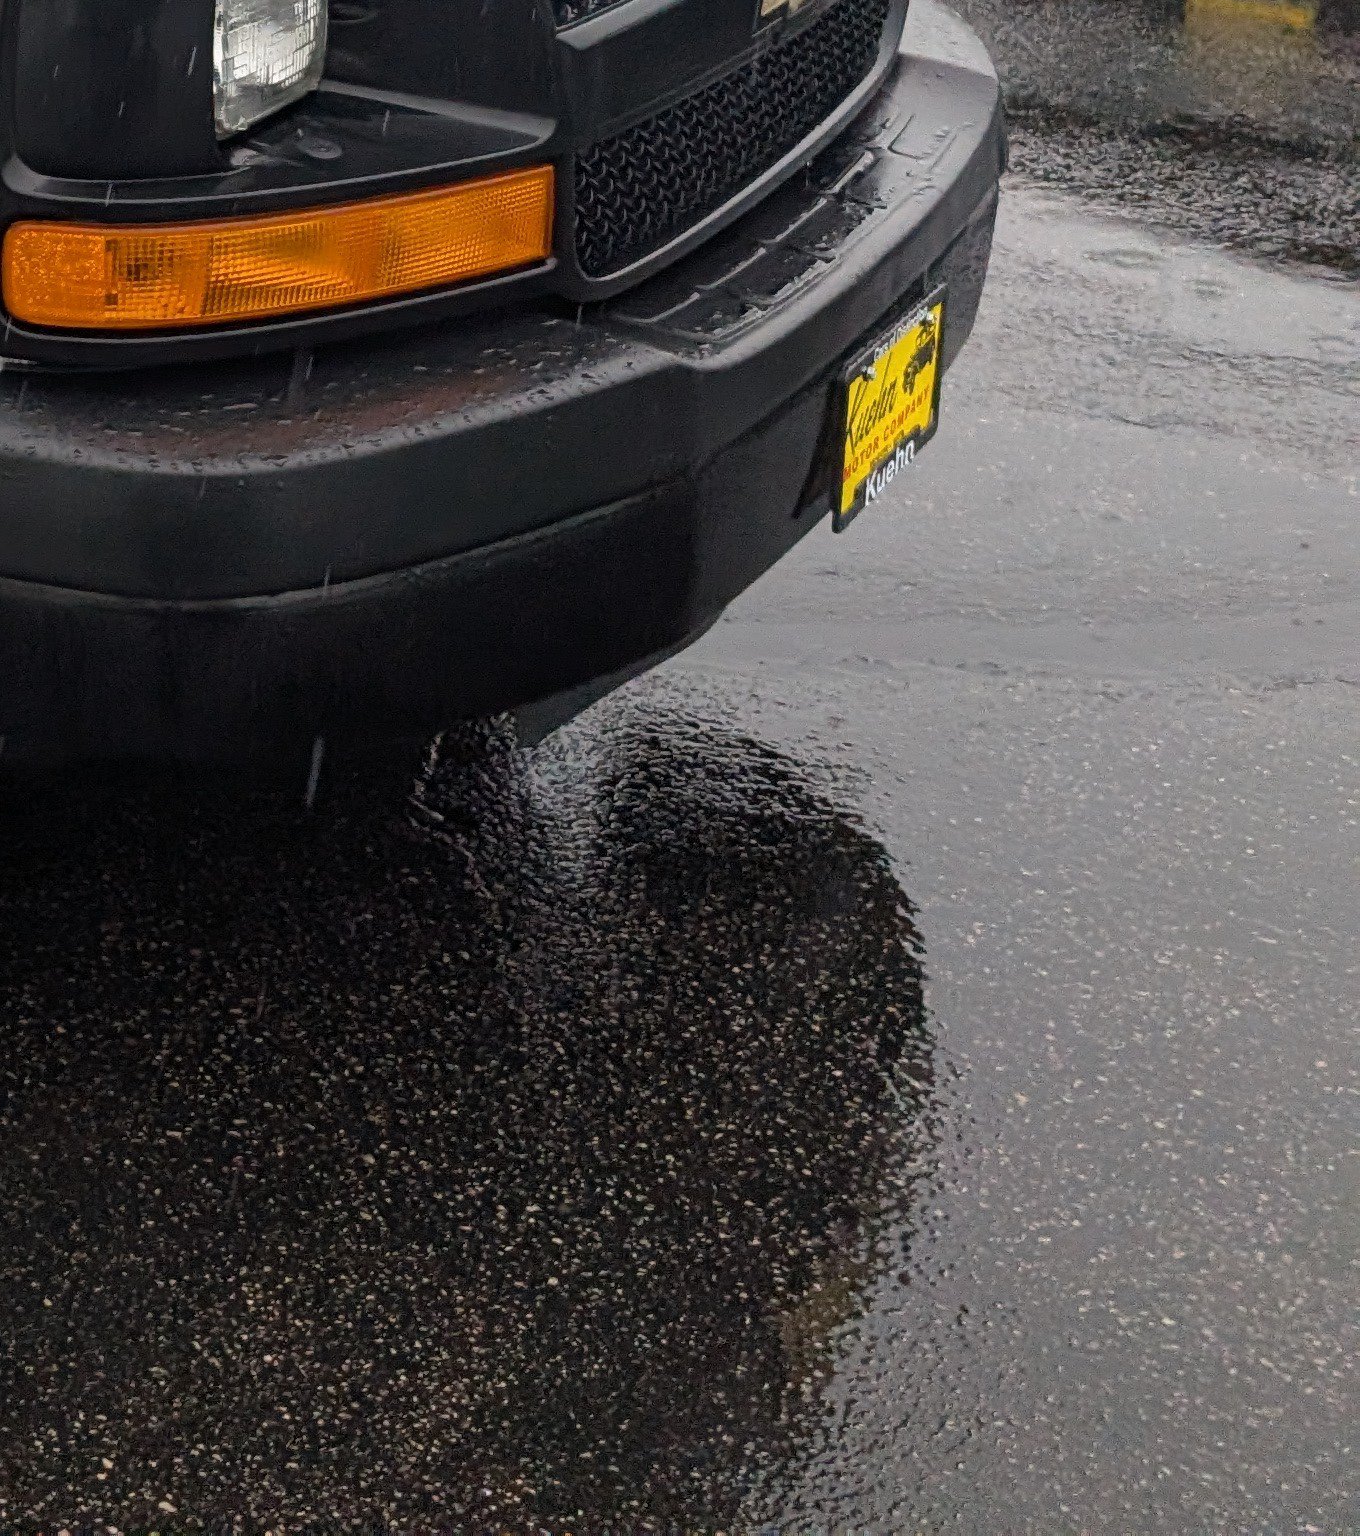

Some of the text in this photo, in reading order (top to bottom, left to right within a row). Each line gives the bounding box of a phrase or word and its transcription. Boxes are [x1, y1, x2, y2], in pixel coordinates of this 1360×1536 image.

[842, 436, 879, 482] MOTOR
[883, 383, 932, 441] COMPANY
[864, 438, 915, 507] Kuehn
